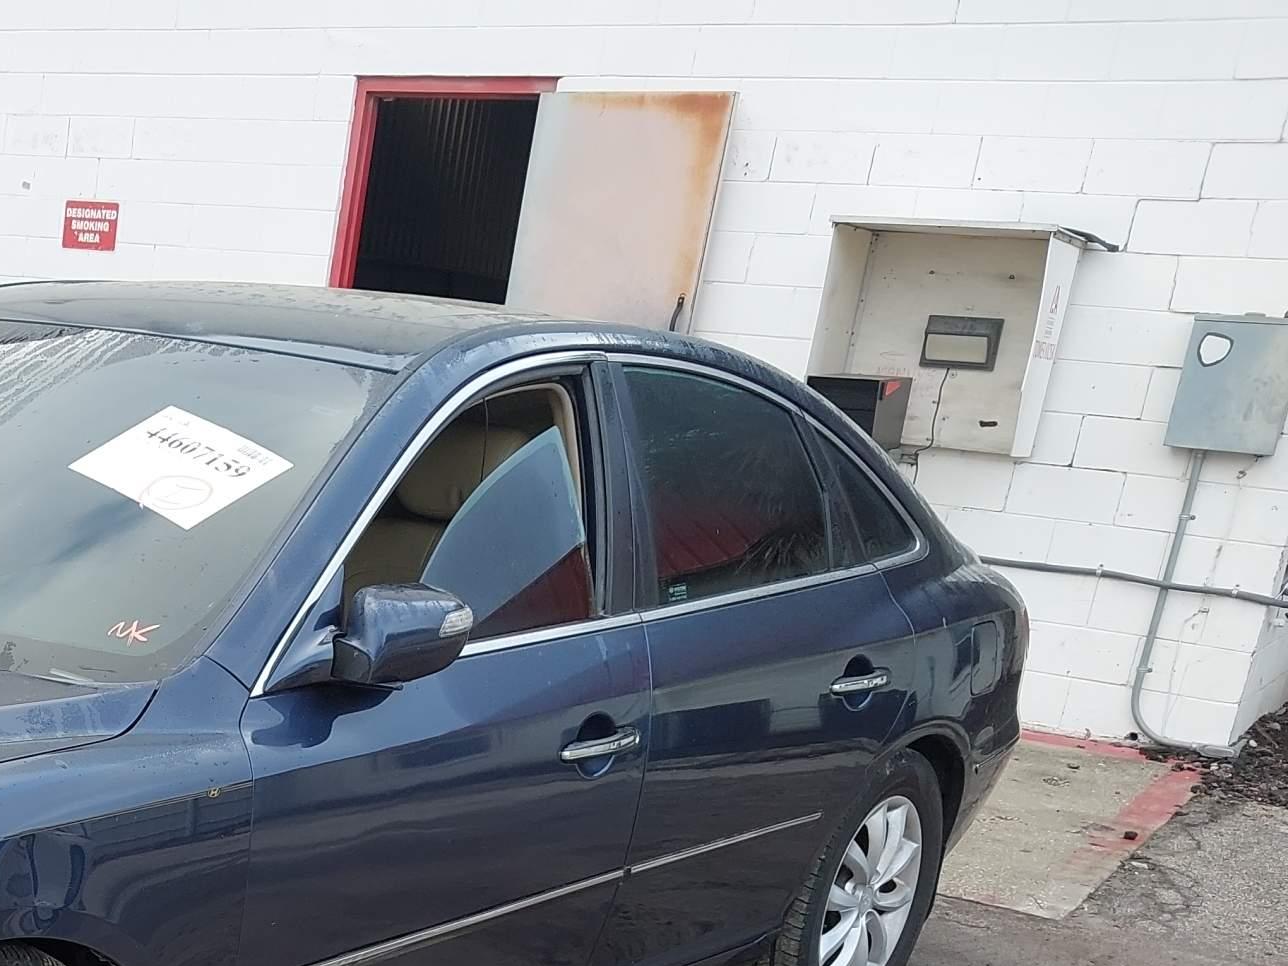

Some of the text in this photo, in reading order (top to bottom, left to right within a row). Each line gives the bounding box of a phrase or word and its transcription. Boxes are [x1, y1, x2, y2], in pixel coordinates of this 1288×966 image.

[66, 208, 117, 220] DESIGNATED
[71, 220, 110, 232] SMOKING
[78, 232, 100, 243] AREA
[146, 427, 251, 478] 44607159
